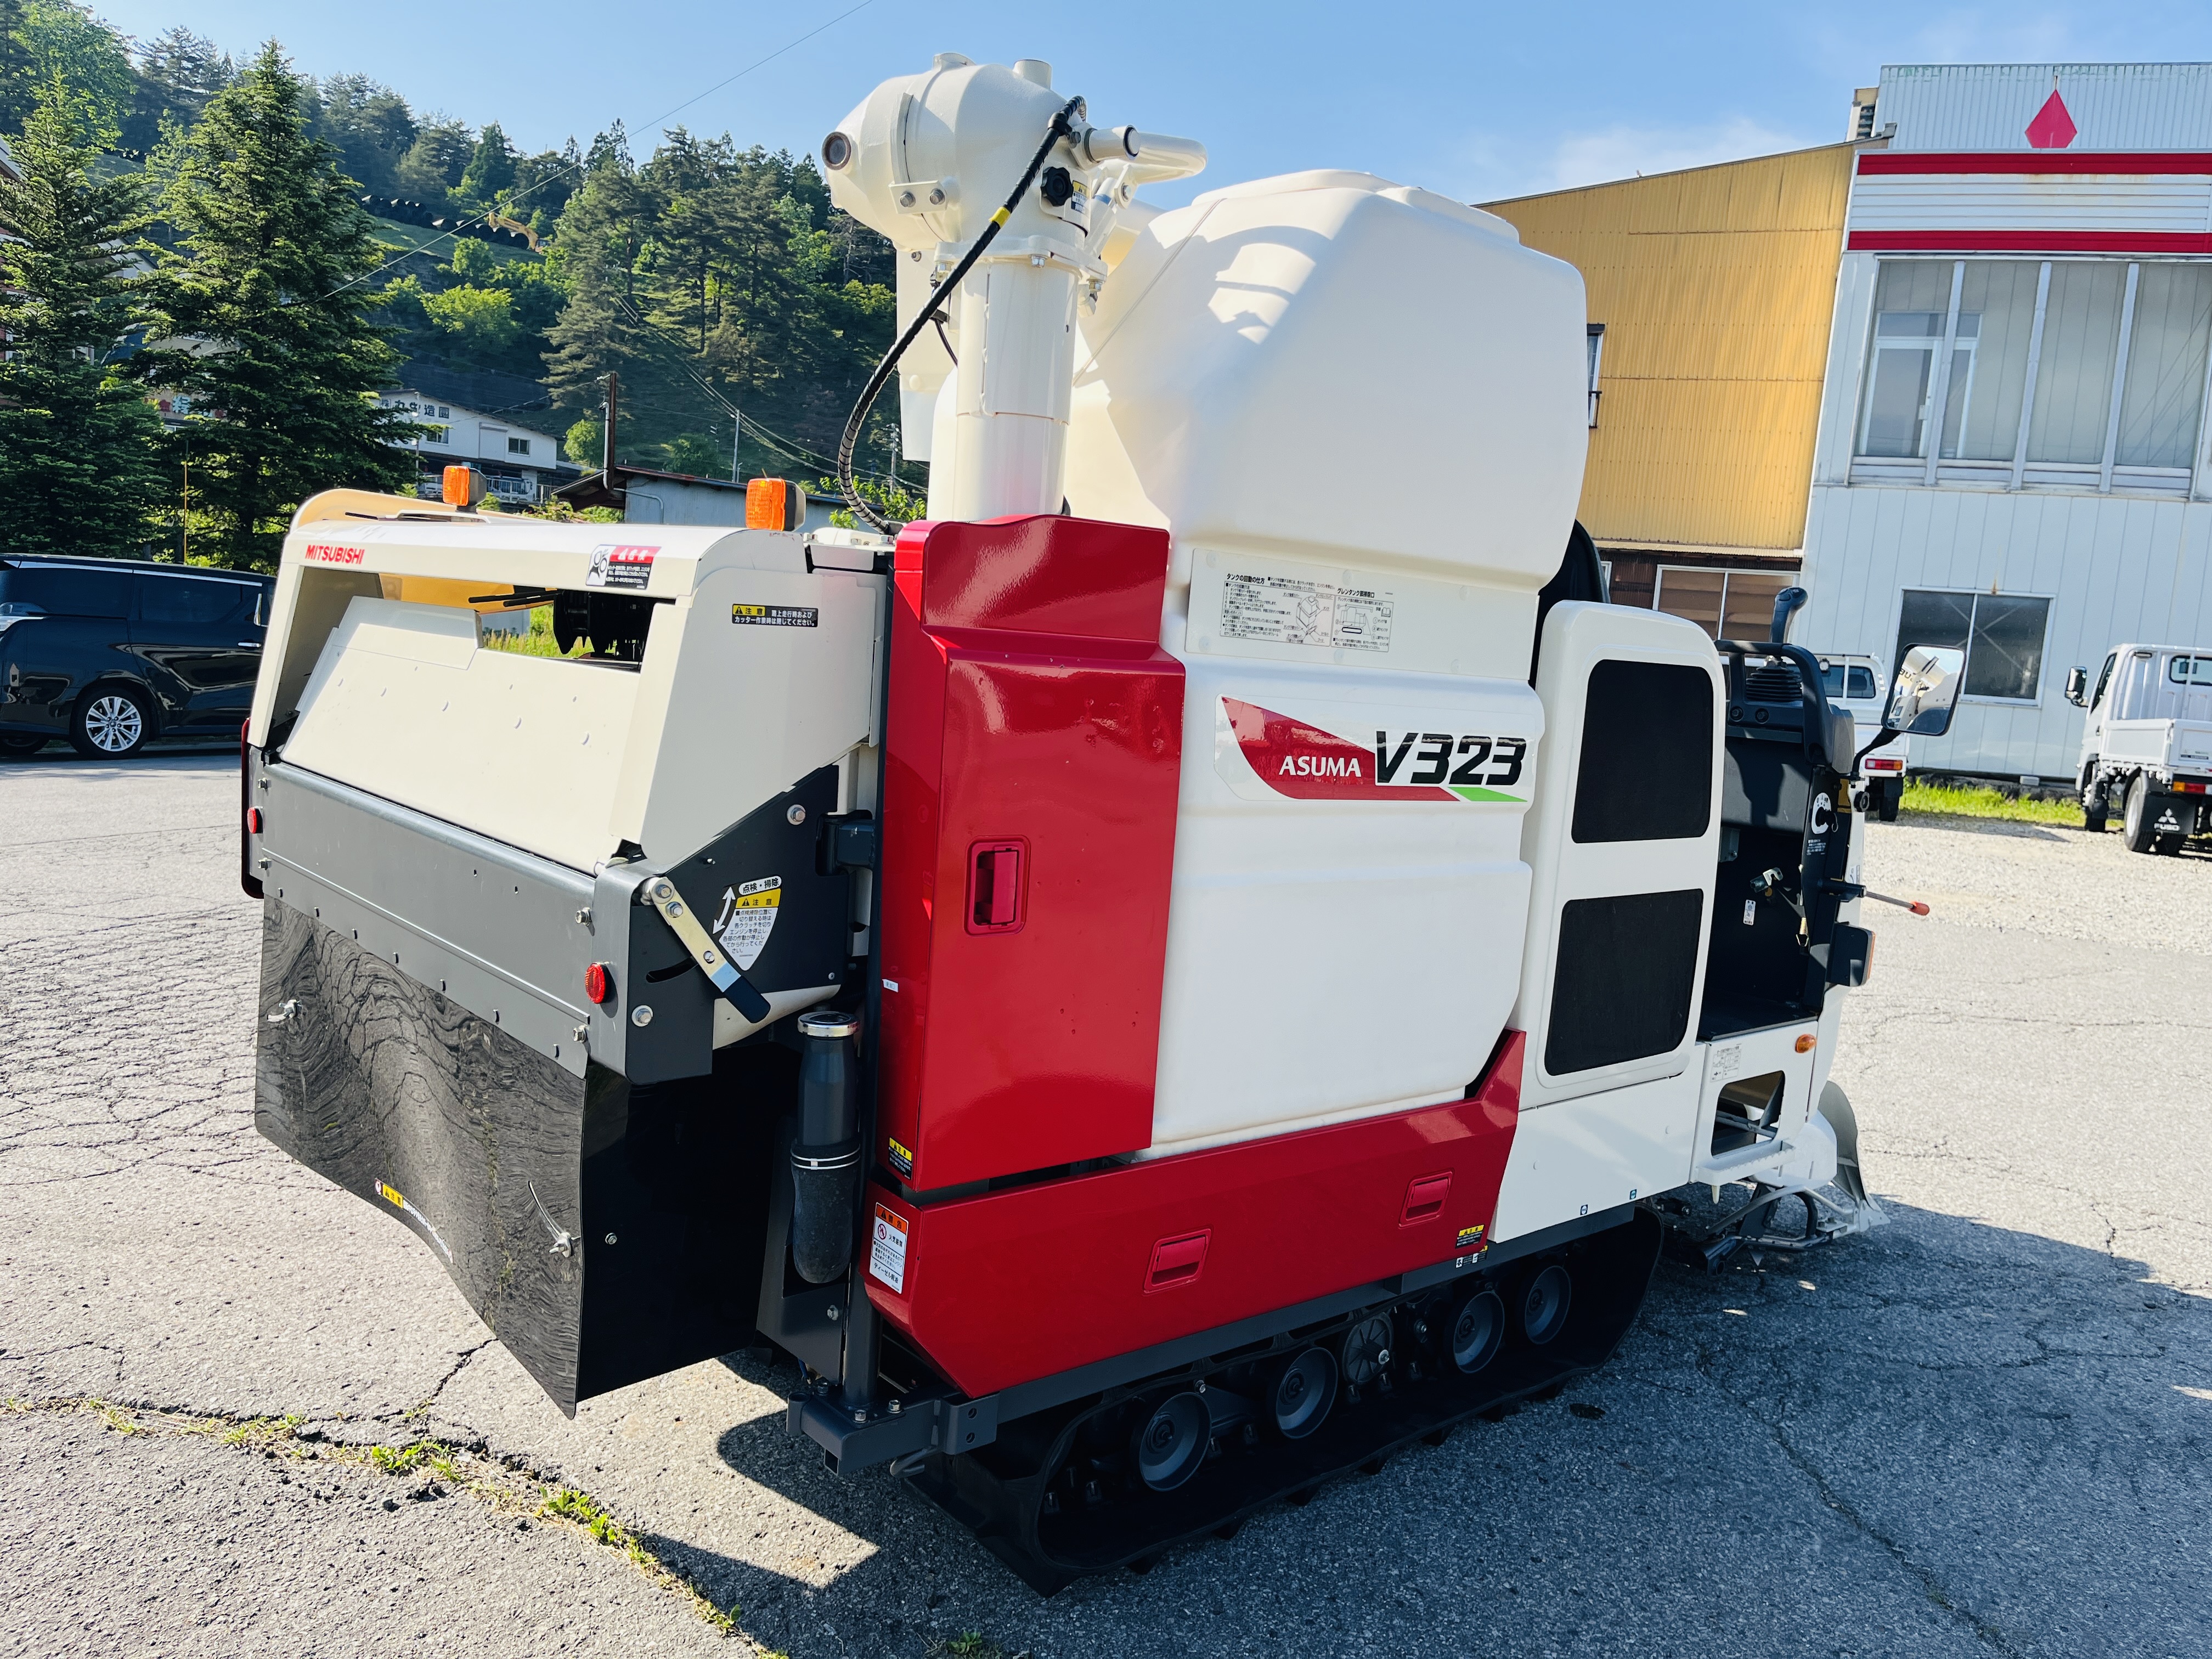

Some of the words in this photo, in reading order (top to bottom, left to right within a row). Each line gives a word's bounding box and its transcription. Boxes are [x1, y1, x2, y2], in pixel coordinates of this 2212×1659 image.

[305, 545, 365, 564] MITSUBISHI
[1279, 755, 1361, 777] ASUMA
[1376, 730, 1526, 786] V323
[743, 878, 779, 893] 点検・掃除
